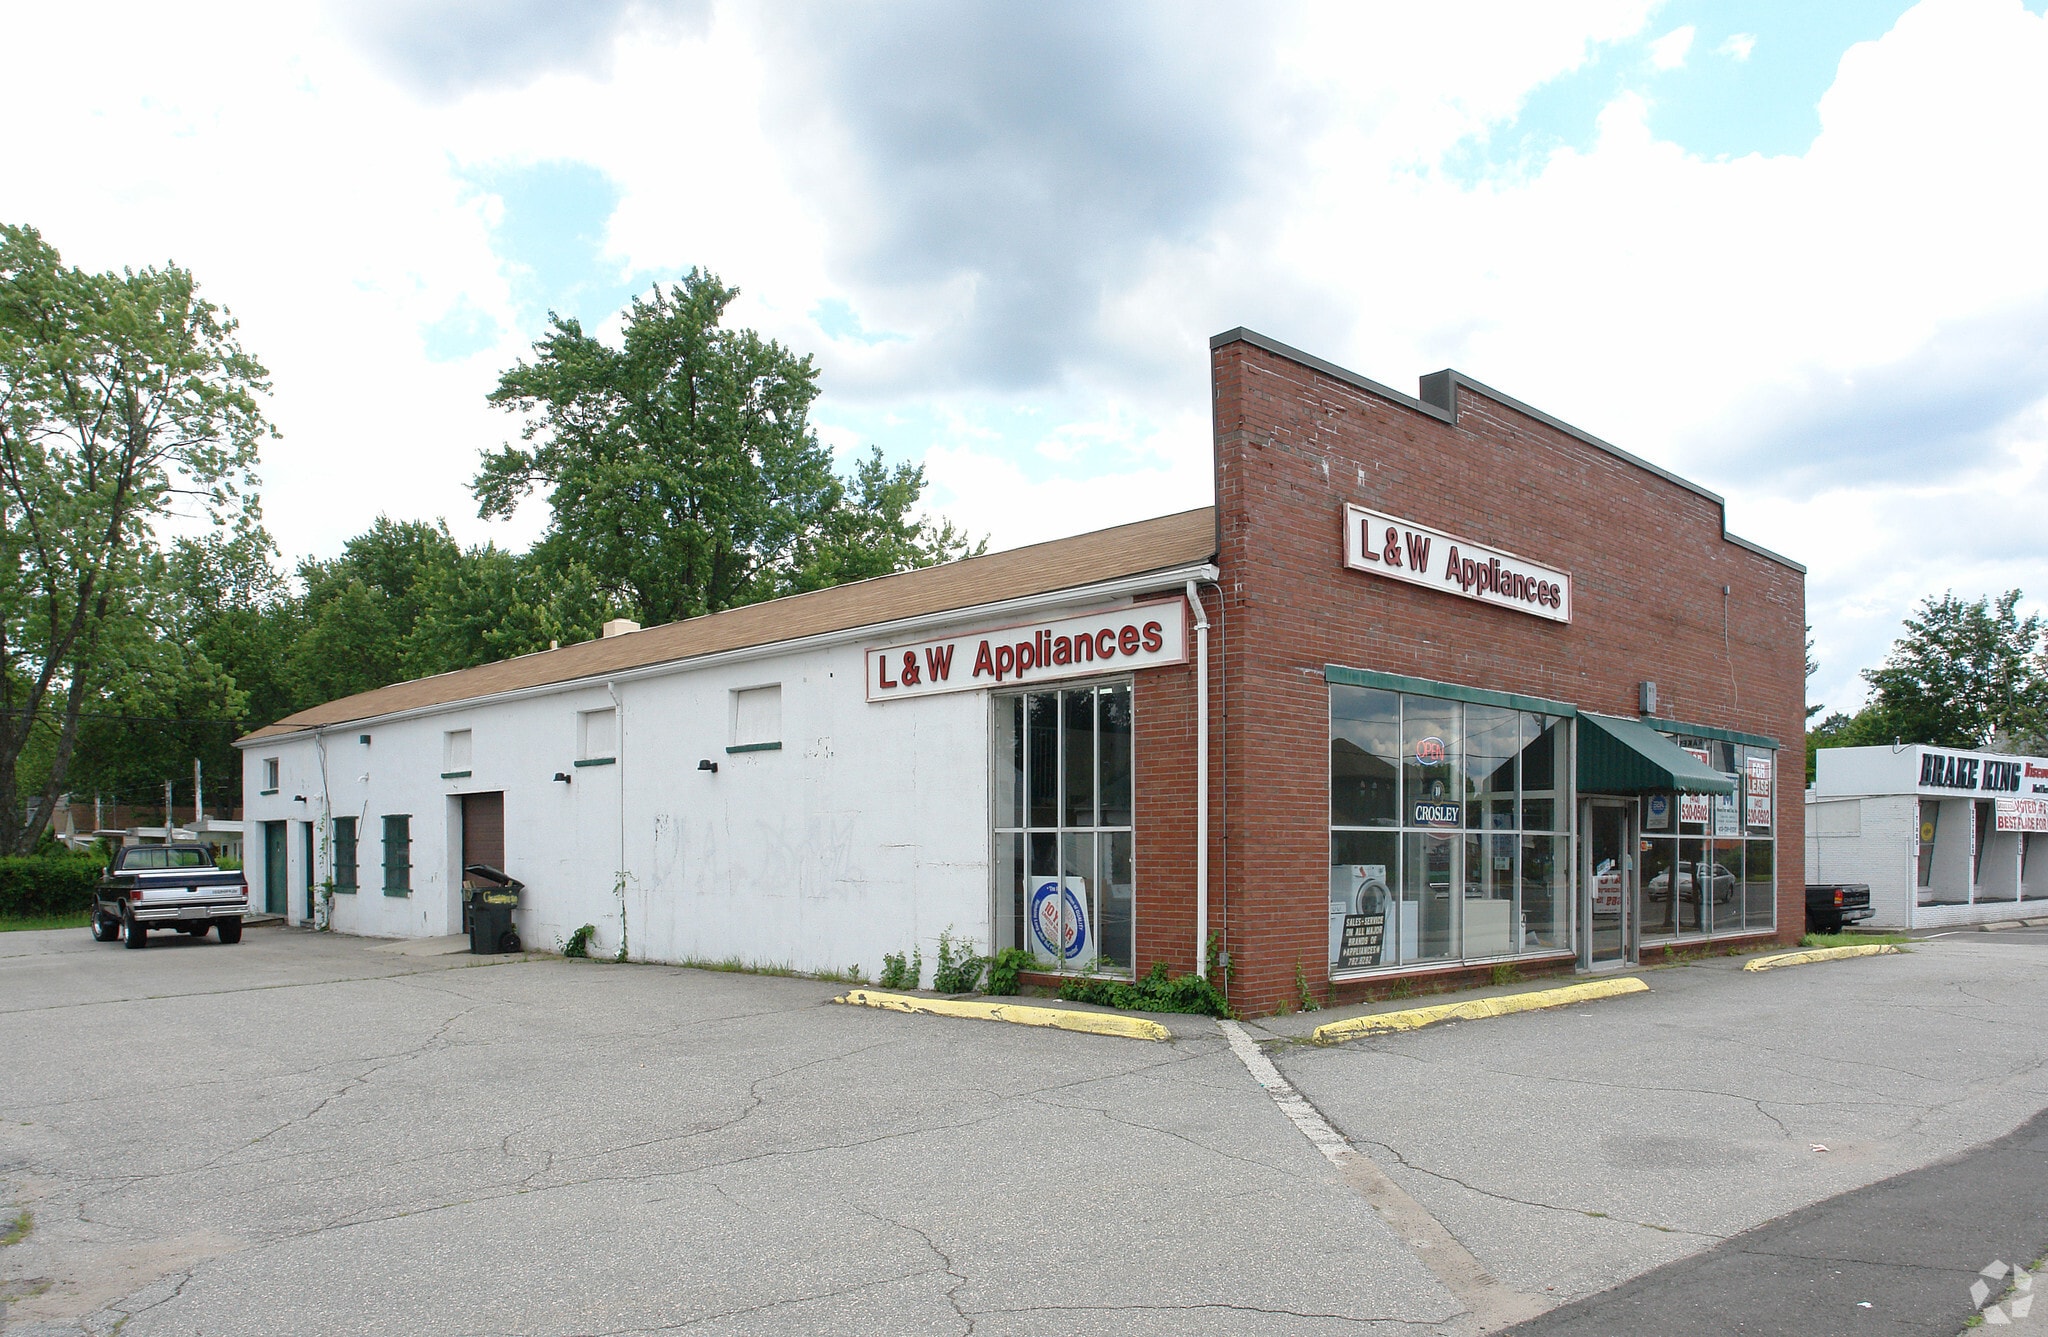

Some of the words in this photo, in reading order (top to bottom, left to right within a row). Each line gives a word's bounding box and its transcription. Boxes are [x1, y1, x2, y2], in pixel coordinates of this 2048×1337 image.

[1445, 545, 1561, 609] Appliances
[972, 620, 1163, 682] Appliances
[1416, 740, 1444, 761] OPEN
[1752, 763, 1765, 779] FOR
[1919, 753, 1979, 789] BRAKE
[1981, 760, 2021, 791] KING
[1748, 775, 1769, 795] LEASE
[1415, 805, 1459, 822] CROSLEY
[1997, 816, 2016, 829] BEST
[1044, 901, 1055, 917] 10
[1355, 927, 1366, 936] ALL
[1366, 925, 1383, 935] MAJOR
[1348, 937, 1369, 946] BRANDS
